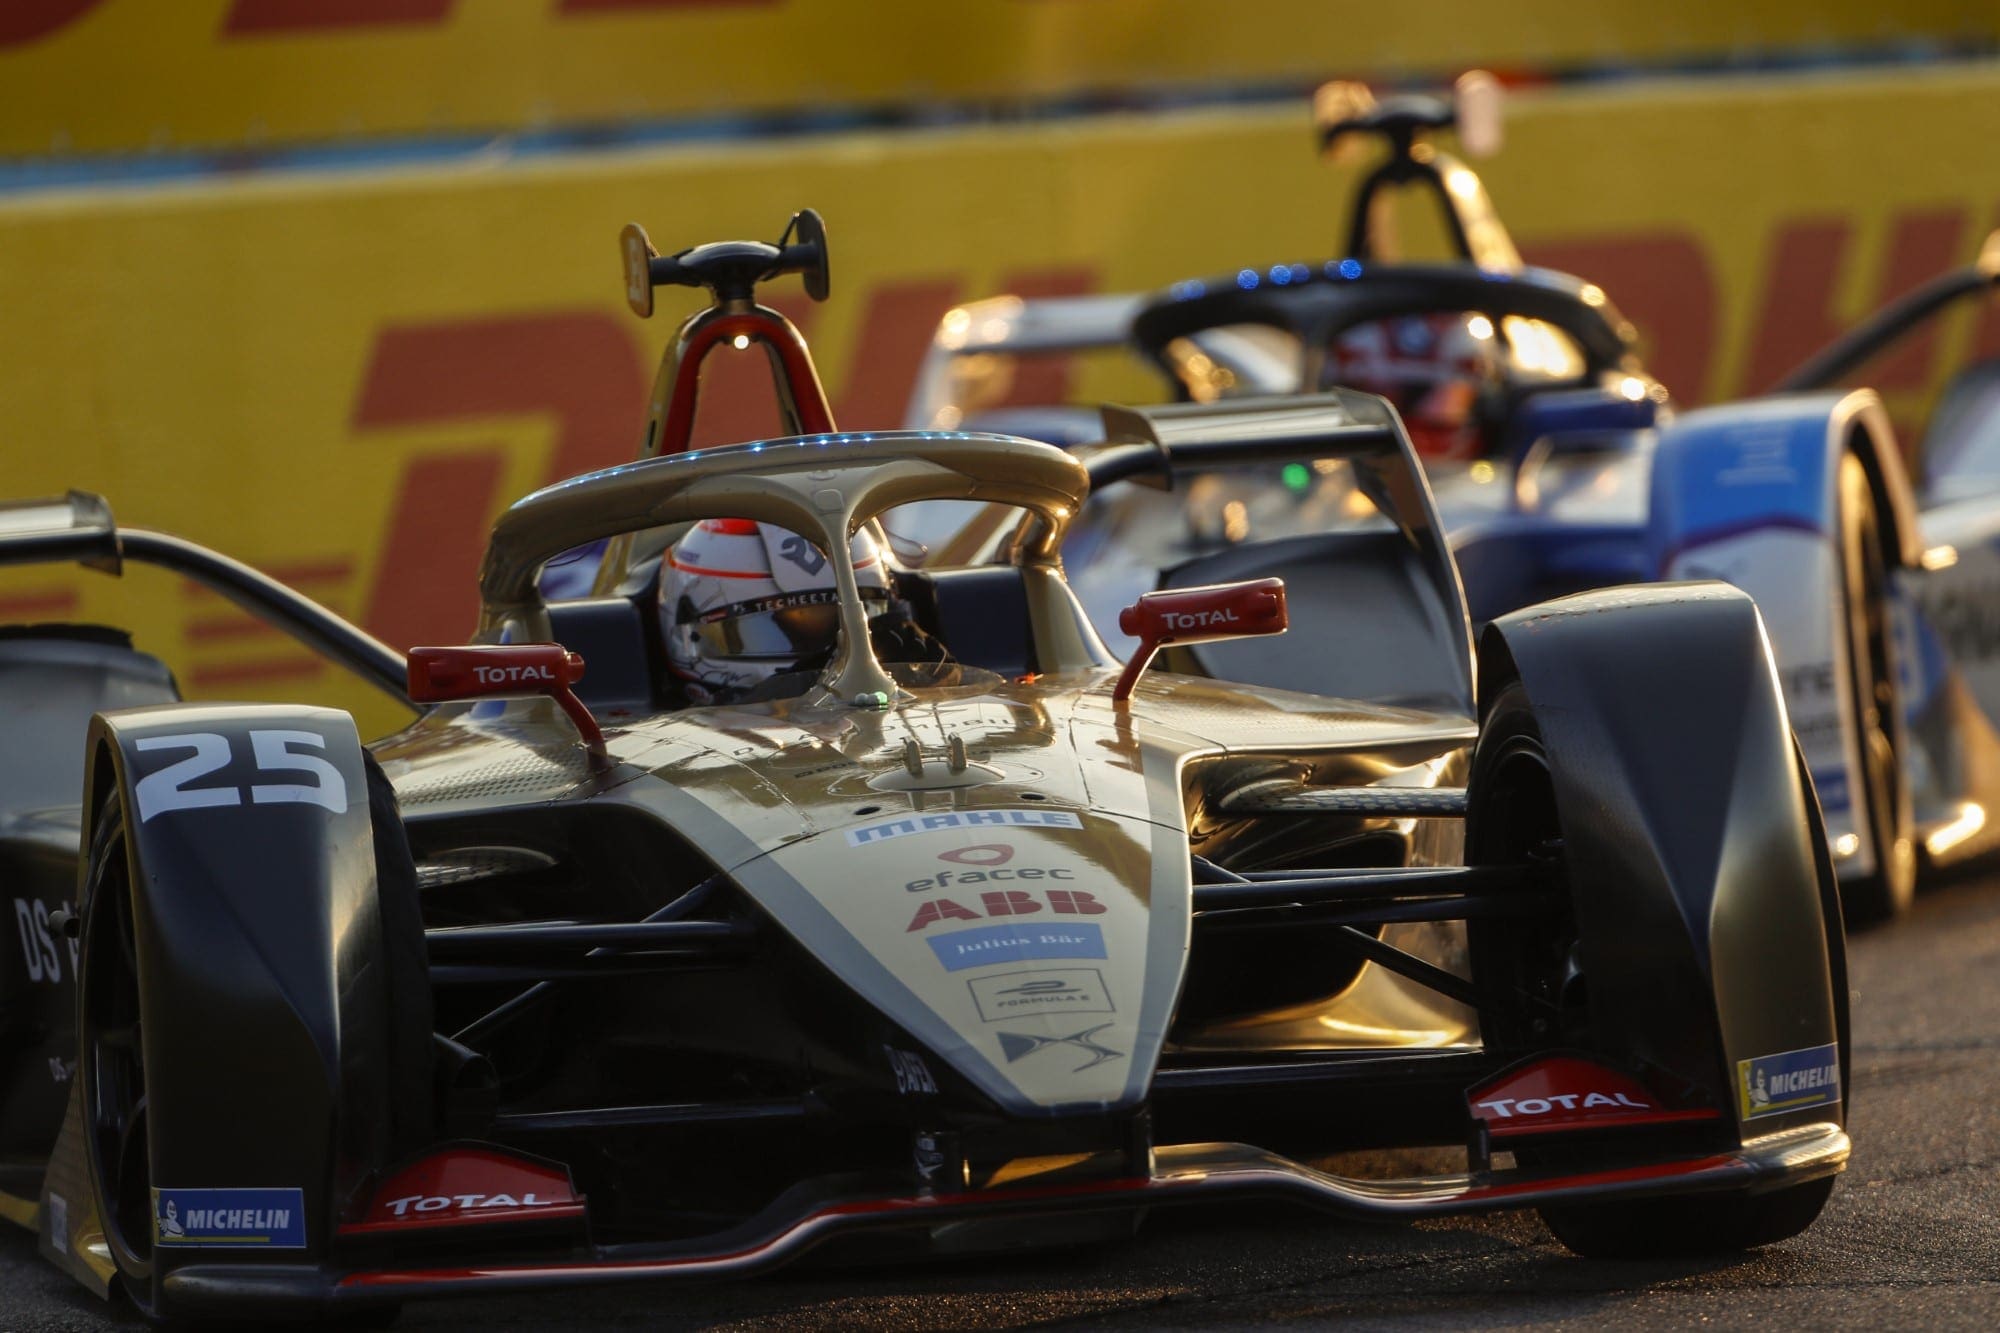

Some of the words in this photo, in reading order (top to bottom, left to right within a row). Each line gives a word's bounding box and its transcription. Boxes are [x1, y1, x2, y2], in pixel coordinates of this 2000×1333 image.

[754, 592, 840, 611] TECHEETA
[1161, 608, 1239, 630] TOTAL
[473, 665, 555, 684] TOTAL
[135, 730, 348, 823] 25
[854, 811, 1074, 843] MAHLE
[905, 867, 1076, 893] efacec
[906, 890, 1107, 932] ABB
[13, 897, 61, 984] DS
[956, 937, 1031, 954] Julius
[1039, 934, 1089, 944] Bär
[997, 995, 1077, 1008] FORMULA
[1770, 1064, 1839, 1095] MICHELIN
[1477, 1092, 1650, 1117] TOTAL
[385, 1193, 553, 1215] TOTAL
[186, 1209, 290, 1229] MICHELIN
